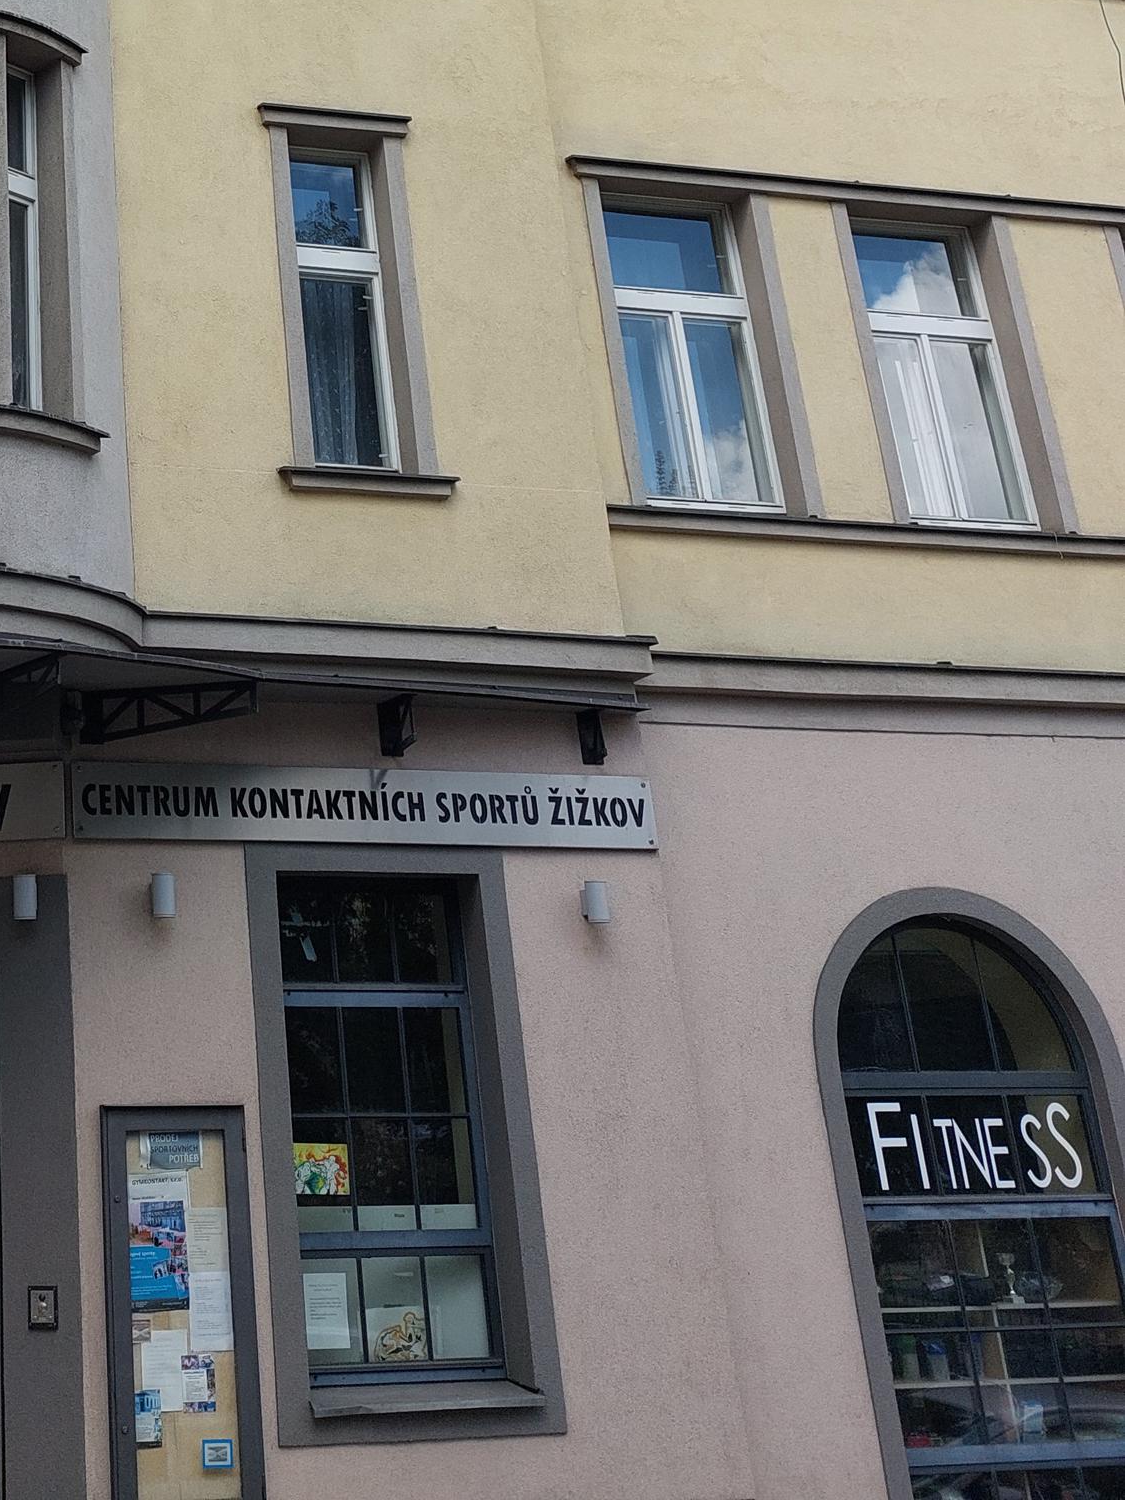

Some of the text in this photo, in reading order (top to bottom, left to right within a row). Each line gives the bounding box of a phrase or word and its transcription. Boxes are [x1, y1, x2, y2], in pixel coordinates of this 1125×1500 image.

[82, 783, 644, 827] CENTRUM KONTAKTNÍCH SPORTŮ ŽIŽKOV
